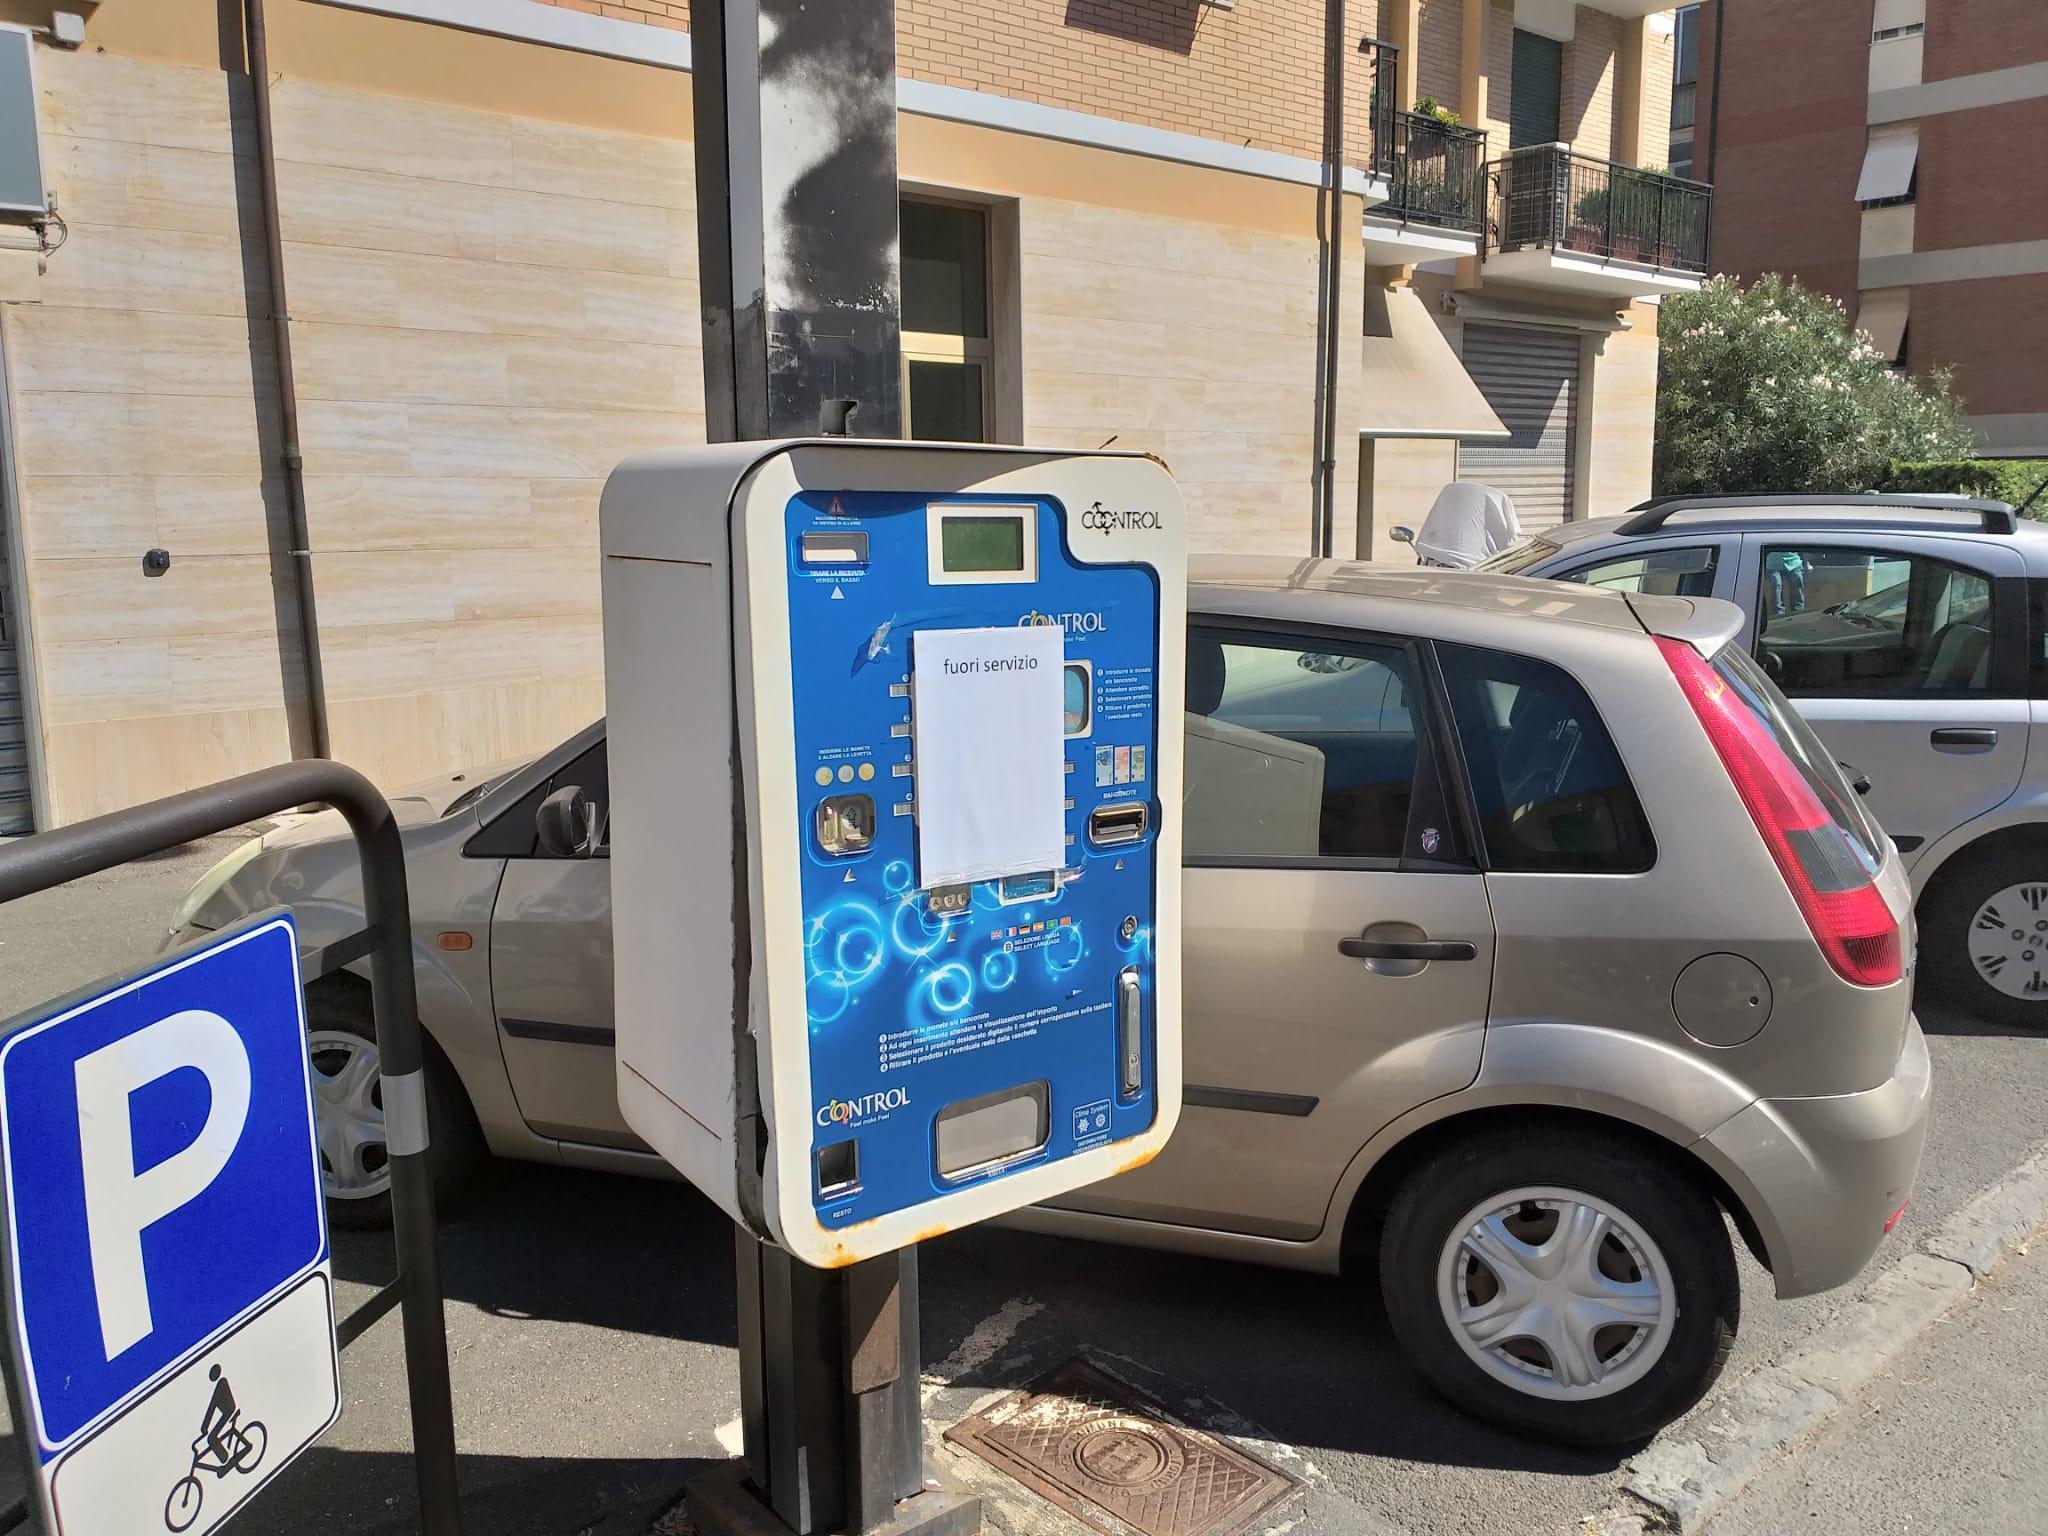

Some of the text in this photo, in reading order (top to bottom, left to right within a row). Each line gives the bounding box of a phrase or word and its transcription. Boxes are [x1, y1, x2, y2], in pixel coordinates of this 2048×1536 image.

[944, 654, 1038, 675] fuori servizio
[1014, 938, 1060, 952] SELECT LANGUAGE
[888, 1028, 919, 1040] Introdurre
[960, 1012, 990, 1024] banconote
[888, 1047, 924, 1060] Selezionare
[930, 1039, 956, 1052] prodotto
[917, 1052, 944, 1064] prodotto
[816, 1086, 912, 1127] CONTROL
[73, 1009, 252, 1363] P
[832, 1207, 852, 1219] RESTO
